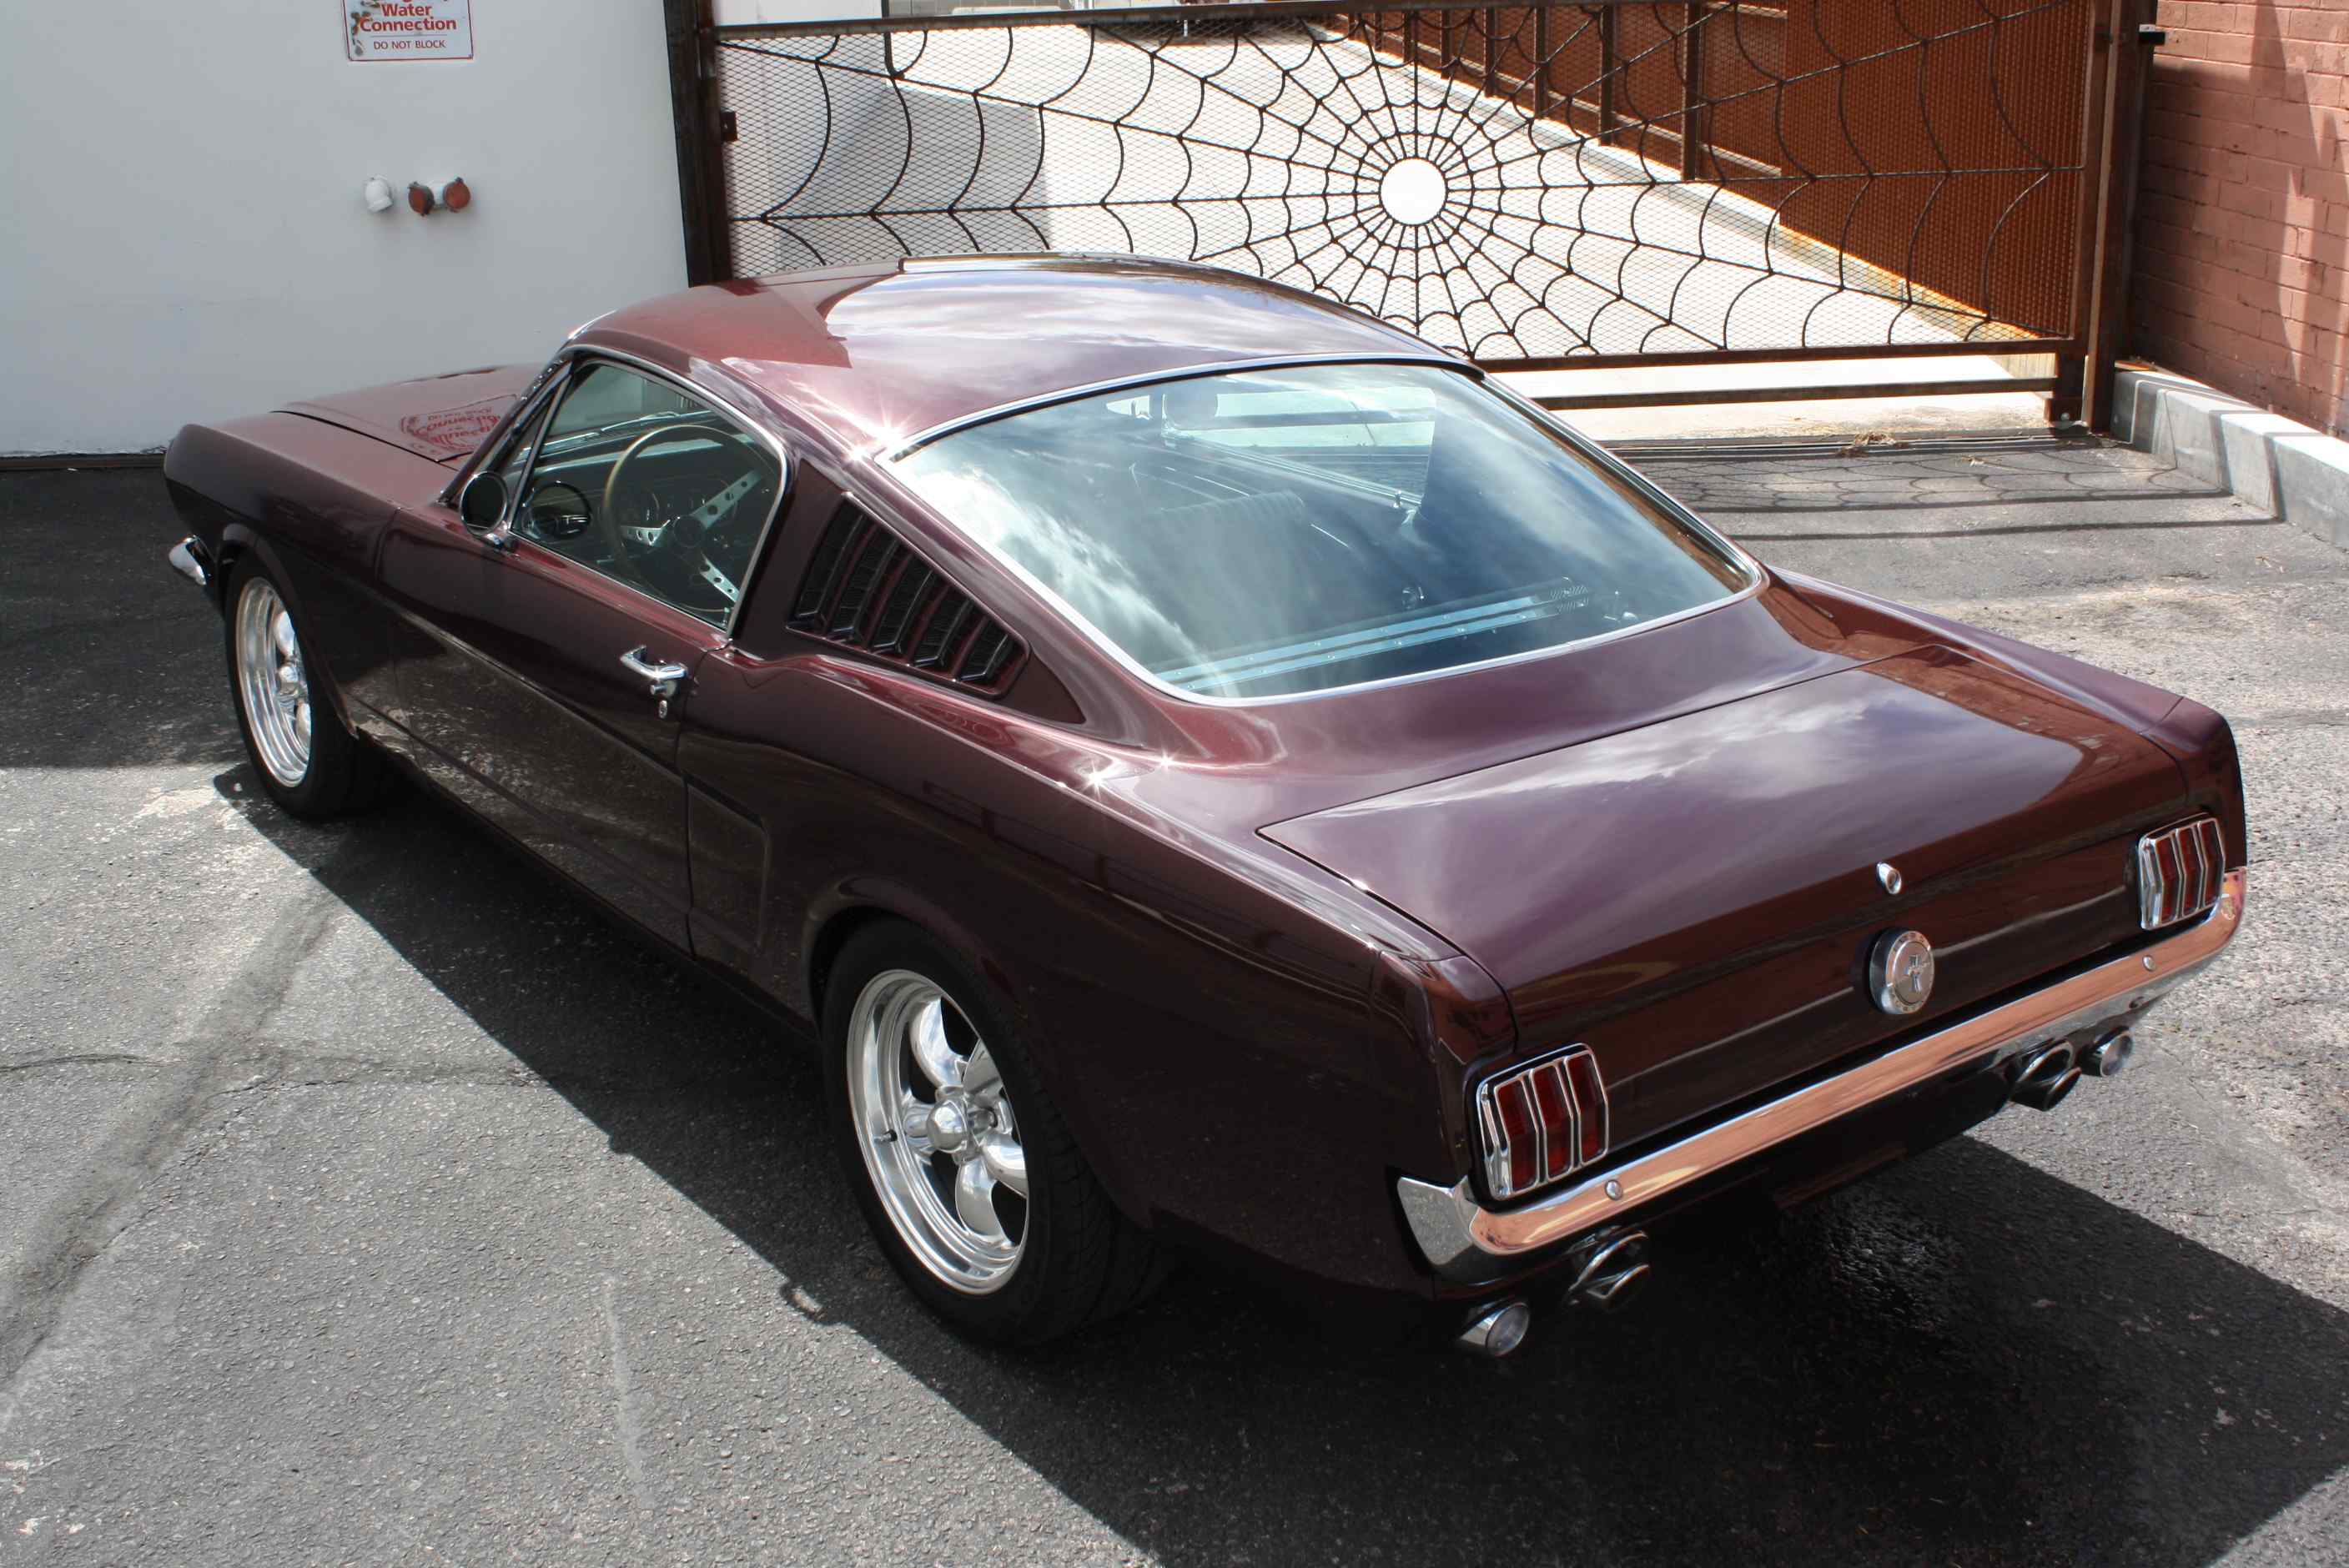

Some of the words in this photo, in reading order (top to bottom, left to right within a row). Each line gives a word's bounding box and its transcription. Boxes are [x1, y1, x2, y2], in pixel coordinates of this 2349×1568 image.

[381, 3, 432, 17] Water
[360, 17, 457, 32] Connection
[374, 41, 388, 49] DO
[392, 40, 410, 49] NOT
[415, 39, 446, 48] BLOCK
